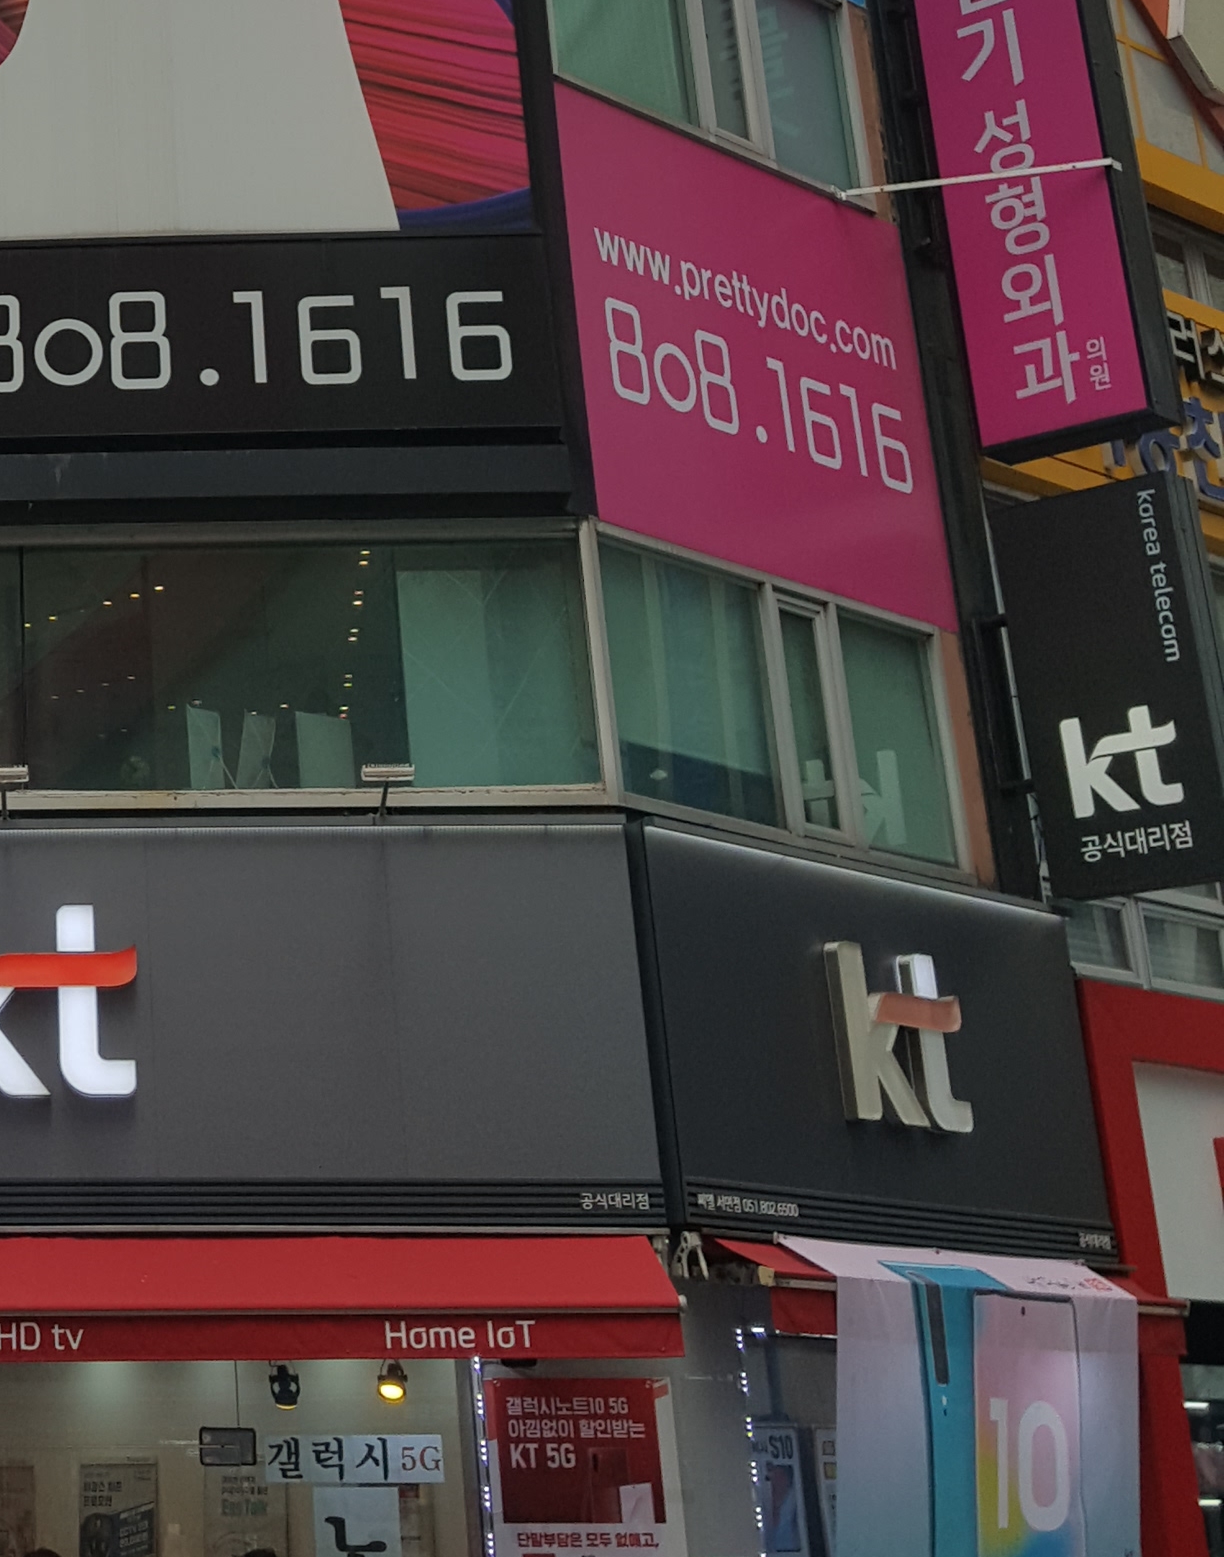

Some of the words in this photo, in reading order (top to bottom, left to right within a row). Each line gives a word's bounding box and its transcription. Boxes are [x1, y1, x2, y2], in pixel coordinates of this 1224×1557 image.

[973, 99, 1080, 405] 성형외과
[594, 227, 897, 370] www.prettydoc.com
[1136, 489, 1161, 557] korea
[1149, 565, 1181, 664] telecom
[1059, 705, 1184, 819] kt
[1080, 820, 1194, 863] 공식대리점
[823, 941, 975, 1134] kt
[579, 1192, 651, 1211] 공식대리점
[52, 1324, 85, 1351] tv
[384, 1320, 476, 1351] Home
[487, 1319, 537, 1349] IoT
[609, 1396, 629, 1415] 5G
[401, 1445, 442, 1472] 5G
[509, 1442, 539, 1469] KT
[546, 1442, 576, 1469] 5G
[989, 1397, 1071, 1532] 10
